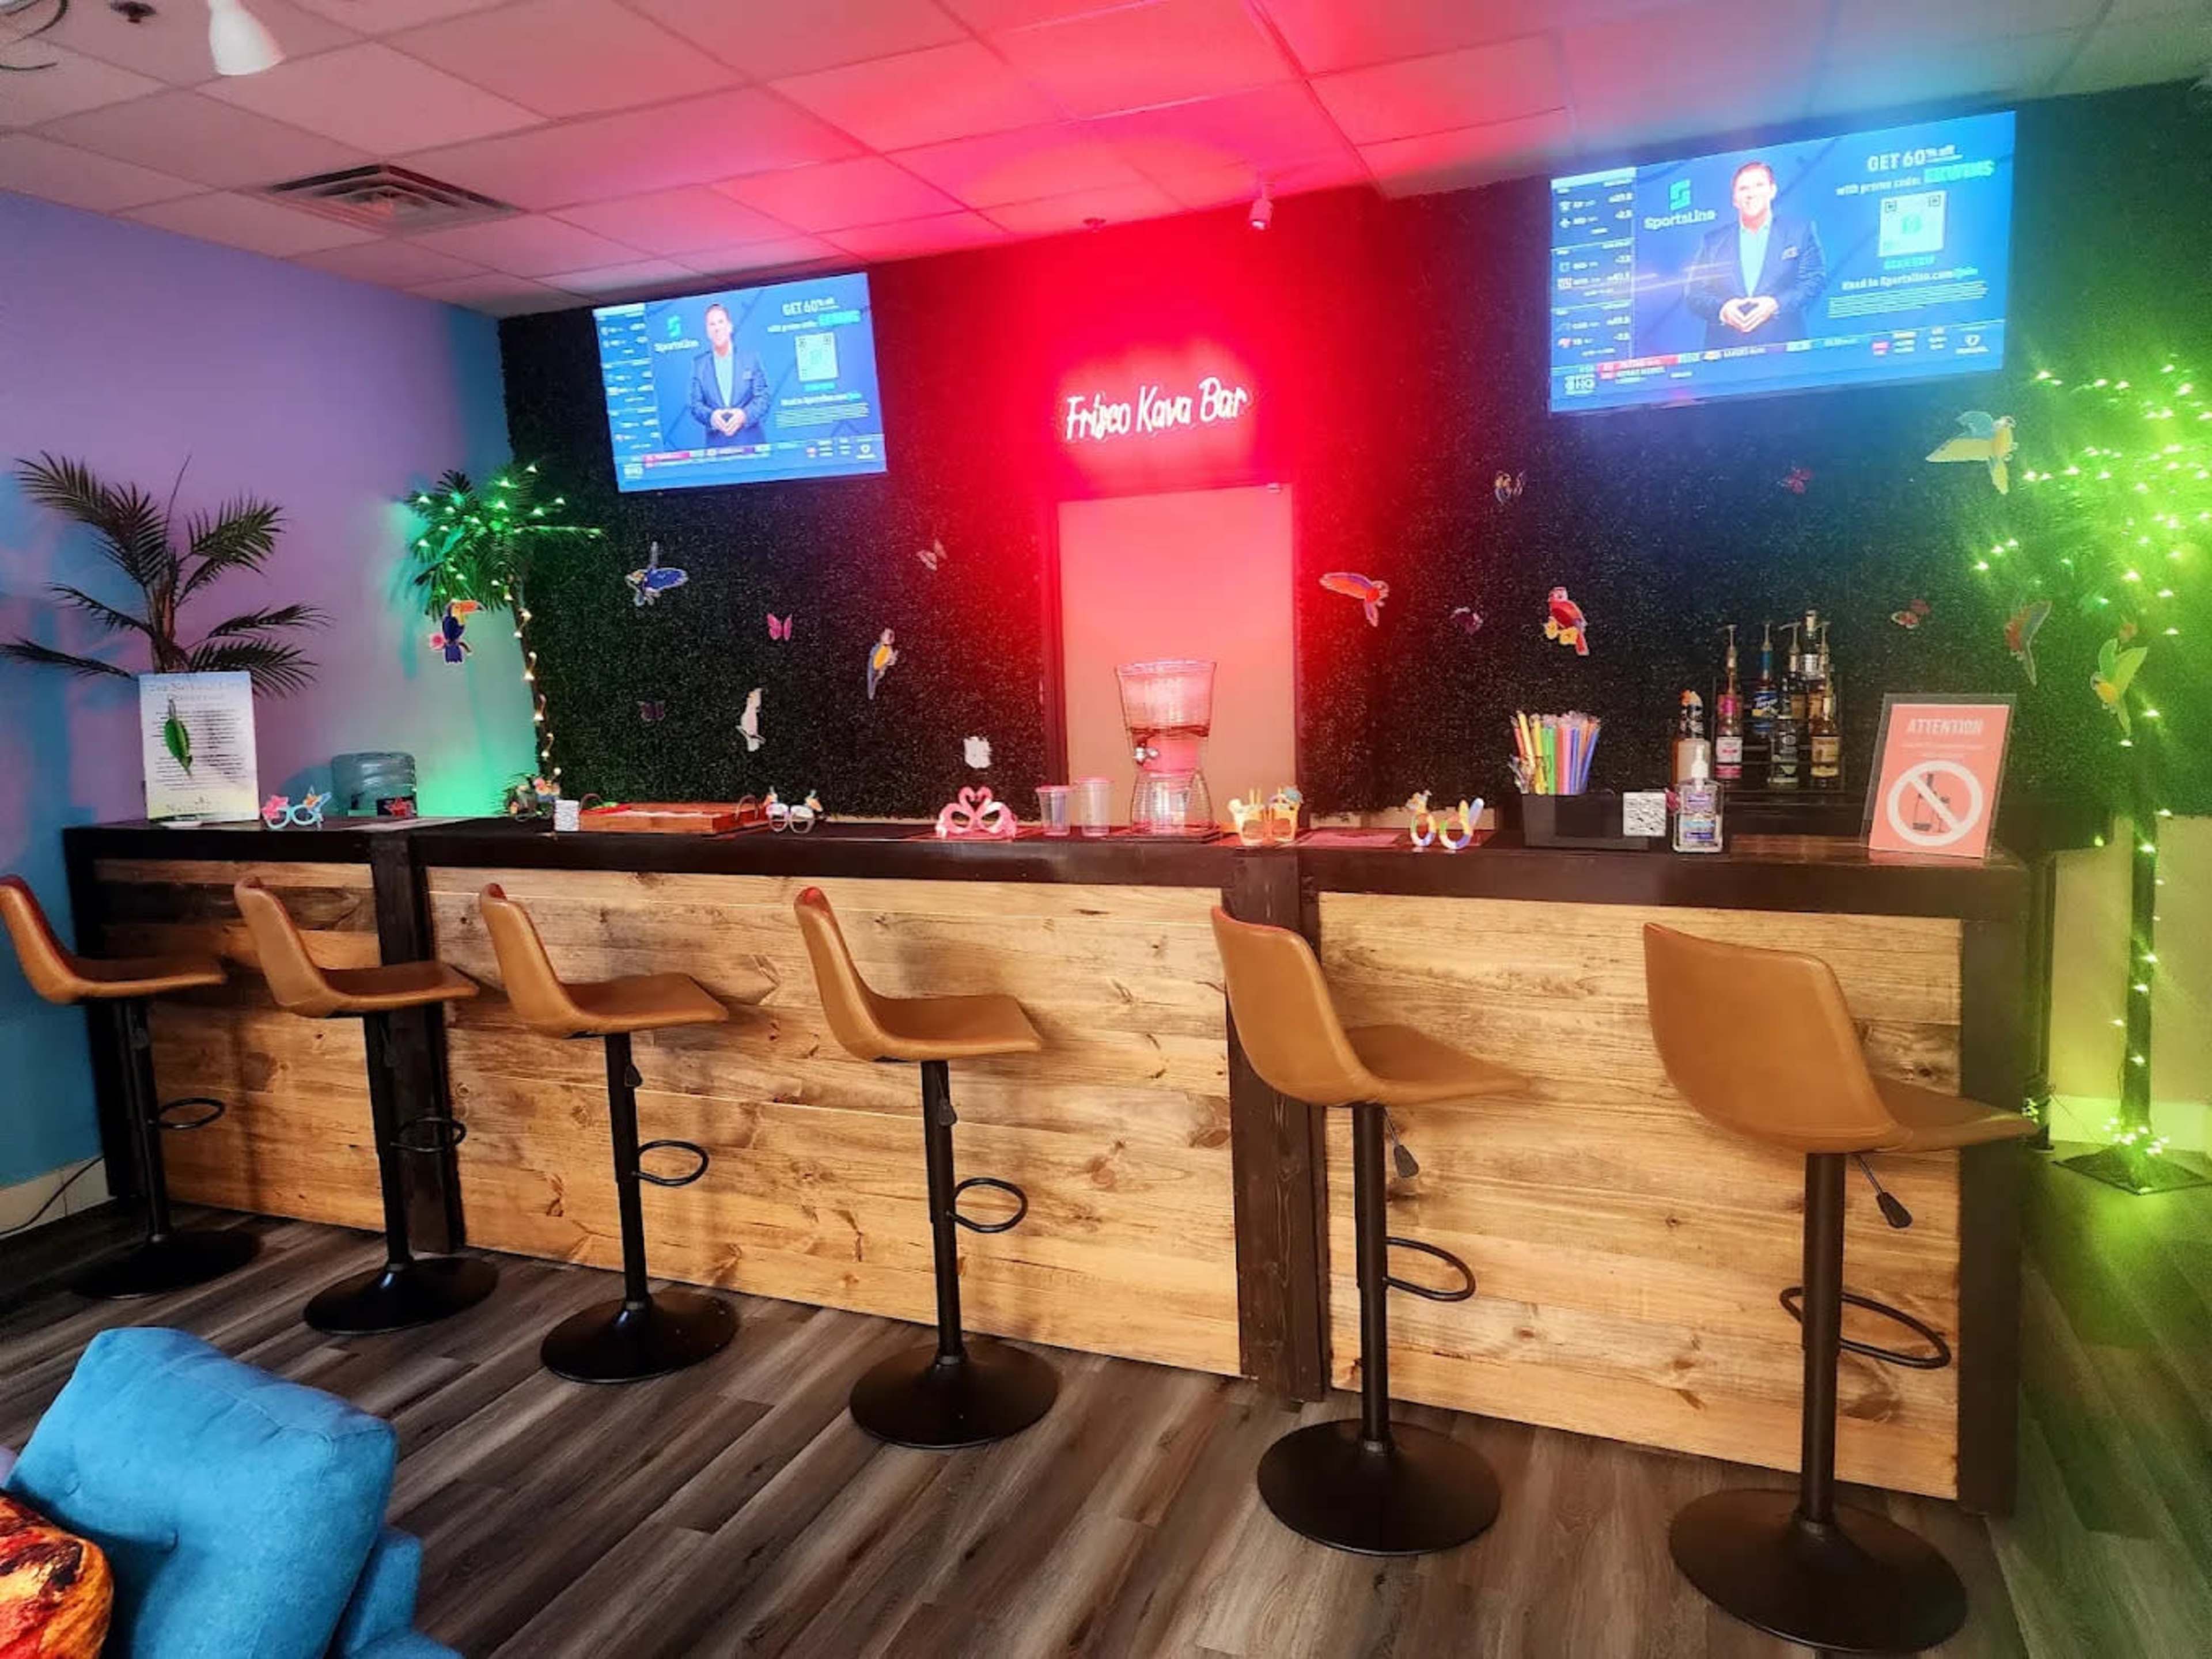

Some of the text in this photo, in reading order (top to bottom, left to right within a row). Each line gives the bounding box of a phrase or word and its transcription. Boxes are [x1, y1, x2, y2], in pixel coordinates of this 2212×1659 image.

[1867, 152, 1900, 172] GET
[1066, 376, 1248, 440] Frisco Kava Bar
[1906, 718, 1984, 735] ATTENTION
